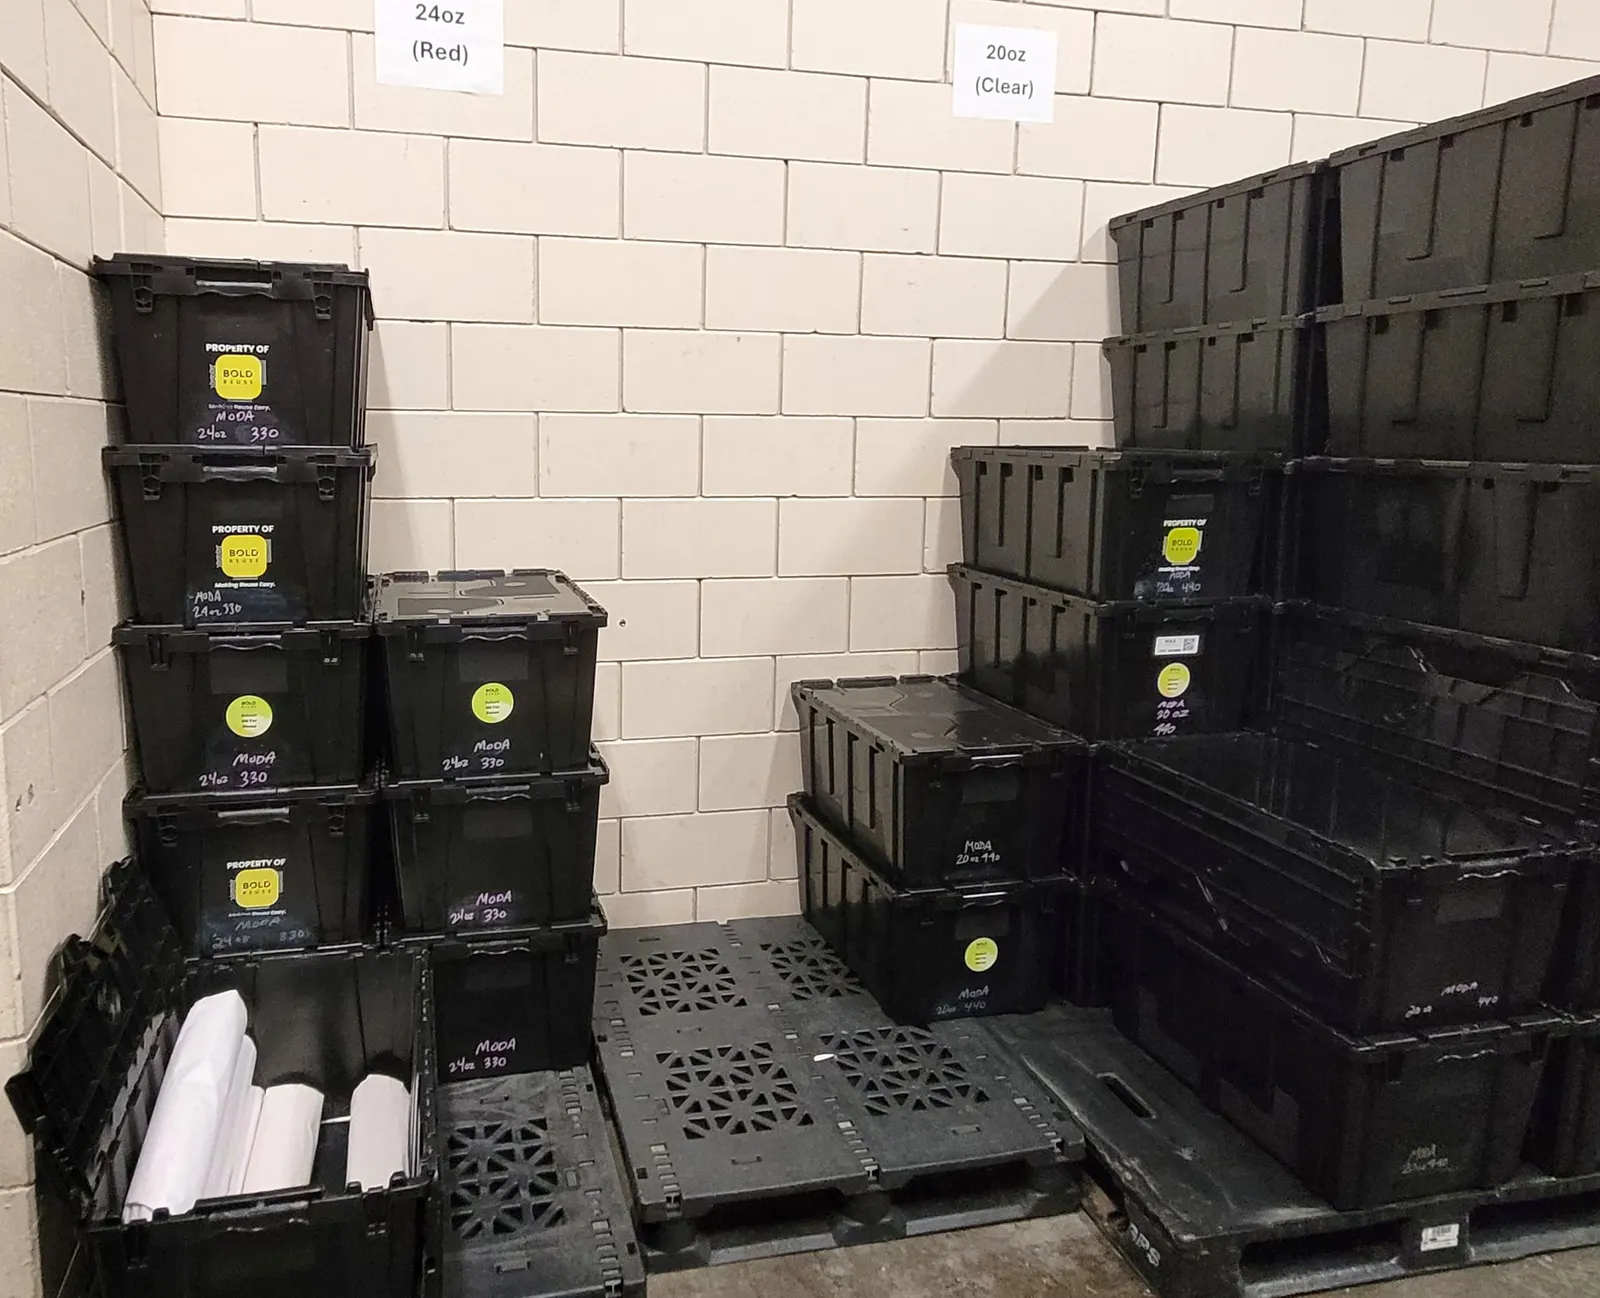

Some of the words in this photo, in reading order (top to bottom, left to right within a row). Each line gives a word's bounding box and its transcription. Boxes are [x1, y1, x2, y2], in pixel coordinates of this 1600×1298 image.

[415, 3, 465, 25] 24oz
[413, 40, 468, 66] (Red)
[986, 44, 1026, 62] 20oz
[976, 76, 1034, 100] (Clear)
[205, 343, 255, 353] PROPERTY
[256, 344, 270, 353] OF
[223, 369, 253, 378] BOLD
[250, 426, 279, 442] 330
[212, 525, 260, 534] PROPERTY
[261, 524, 275, 533] OF
[229, 549, 259, 557] BOLD
[222, 603, 242, 615] 330
[481, 757, 504, 769] 330
[239, 771, 267, 788] 330
[226, 859, 272, 870] PROPERTY
[273, 858, 287, 866] OF
[243, 880, 271, 890] BOLD
[483, 908, 507, 922] 330
[484, 1057, 507, 1069] 330
